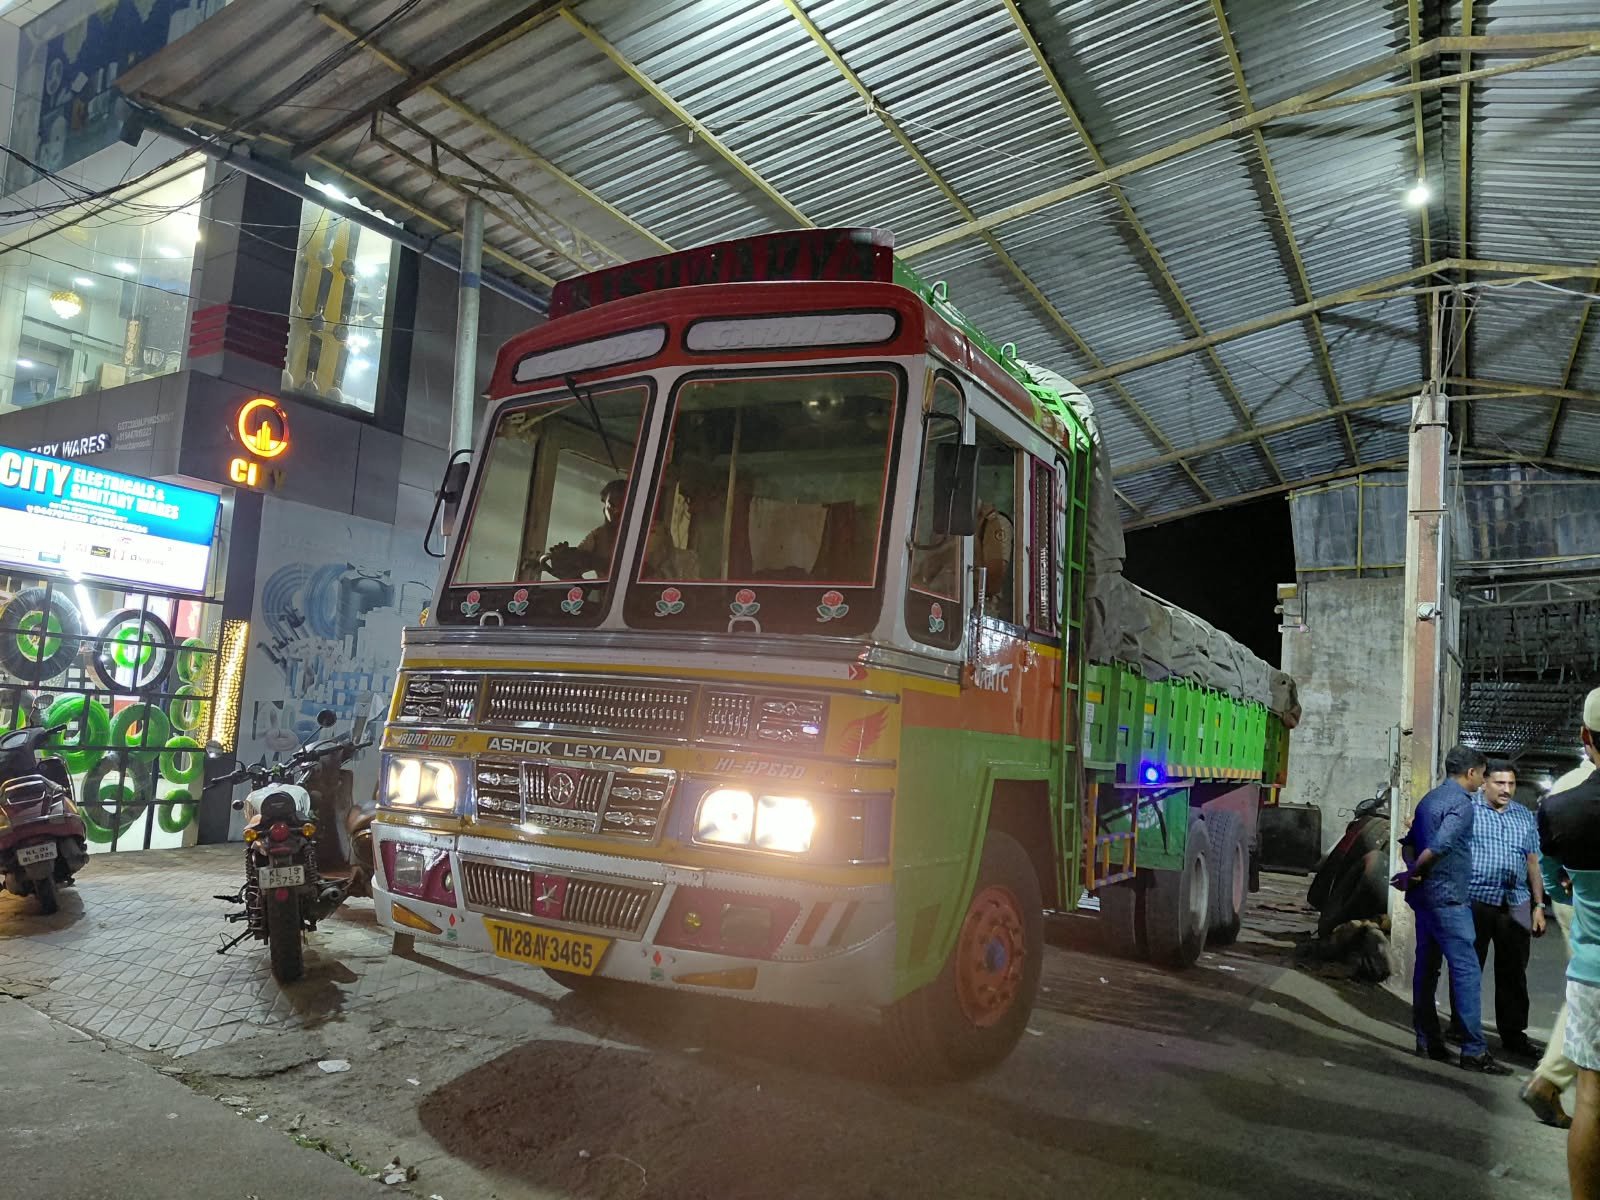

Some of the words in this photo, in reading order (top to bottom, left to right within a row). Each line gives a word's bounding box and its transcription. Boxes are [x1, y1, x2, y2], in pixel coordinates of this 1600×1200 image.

[62, 433, 106, 458] WARES
[0, 451, 72, 497] CITY
[73, 467, 155, 499] ELECTRICALS
[70, 483, 136, 511] SANITARY
[136, 497, 179, 520] WARES
[400, 733, 427, 745] ROAD
[428, 734, 456, 747] KING
[488, 737, 552, 755] ASHOK
[563, 743, 661, 764] LEYLAND
[269, 869, 282, 877] KL
